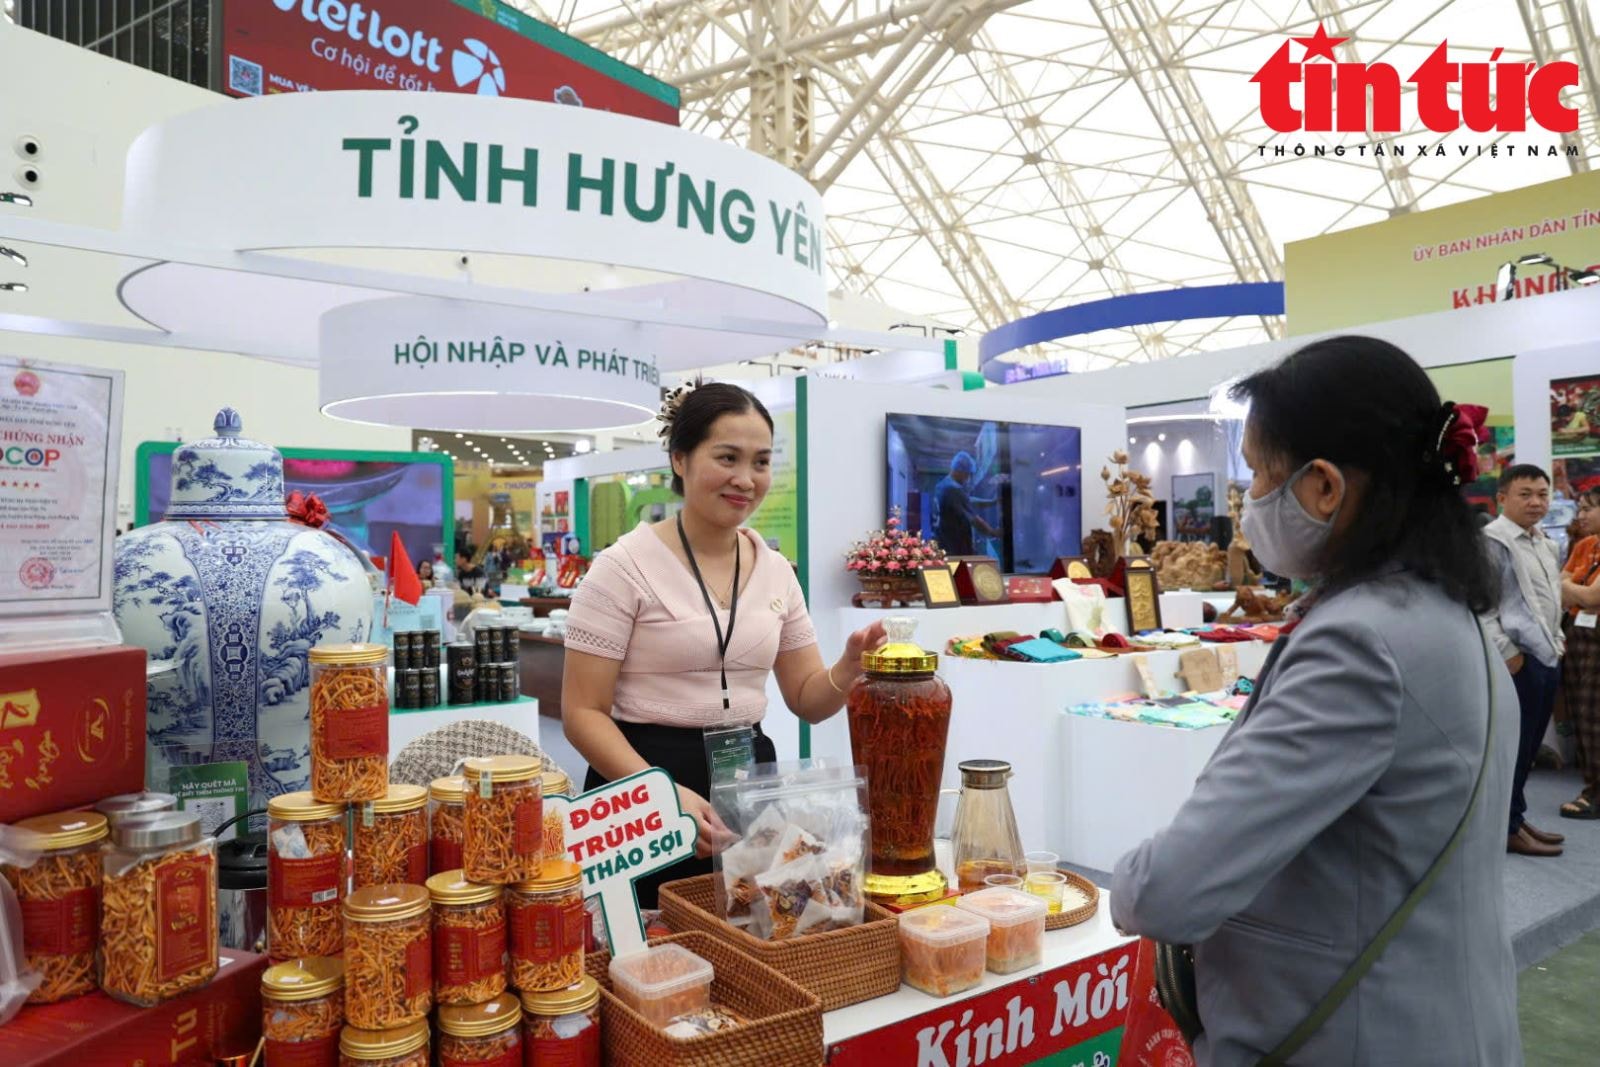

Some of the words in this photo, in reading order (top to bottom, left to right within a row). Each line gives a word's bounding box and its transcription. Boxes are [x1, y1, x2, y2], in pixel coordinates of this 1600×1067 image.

[311, 38, 338, 61] Cơ
[340, 47, 371, 75] hội
[342, 115, 539, 207] TỈNH
[567, 152, 755, 244] HƯNG
[769, 200, 822, 277] YÊN
[1439, 239, 1471, 257] BAN
[1476, 227, 1523, 249] NHÂN
[1529, 218, 1566, 238] DÂN
[394, 335, 438, 368] HỘI
[448, 336, 525, 368] NHẬP
[535, 340, 568, 368] VÀ
[578, 349, 629, 376] PHÁT
[0, 446, 61, 466] COP
[569, 784, 650, 831] ĐÔNG
[567, 810, 663, 863] TRÙNG
[582, 848, 644, 885] THẢO
[648, 829, 684, 859] SỢI
[916, 995, 1035, 1067] Kính
[1050, 954, 1129, 1037] Mời
